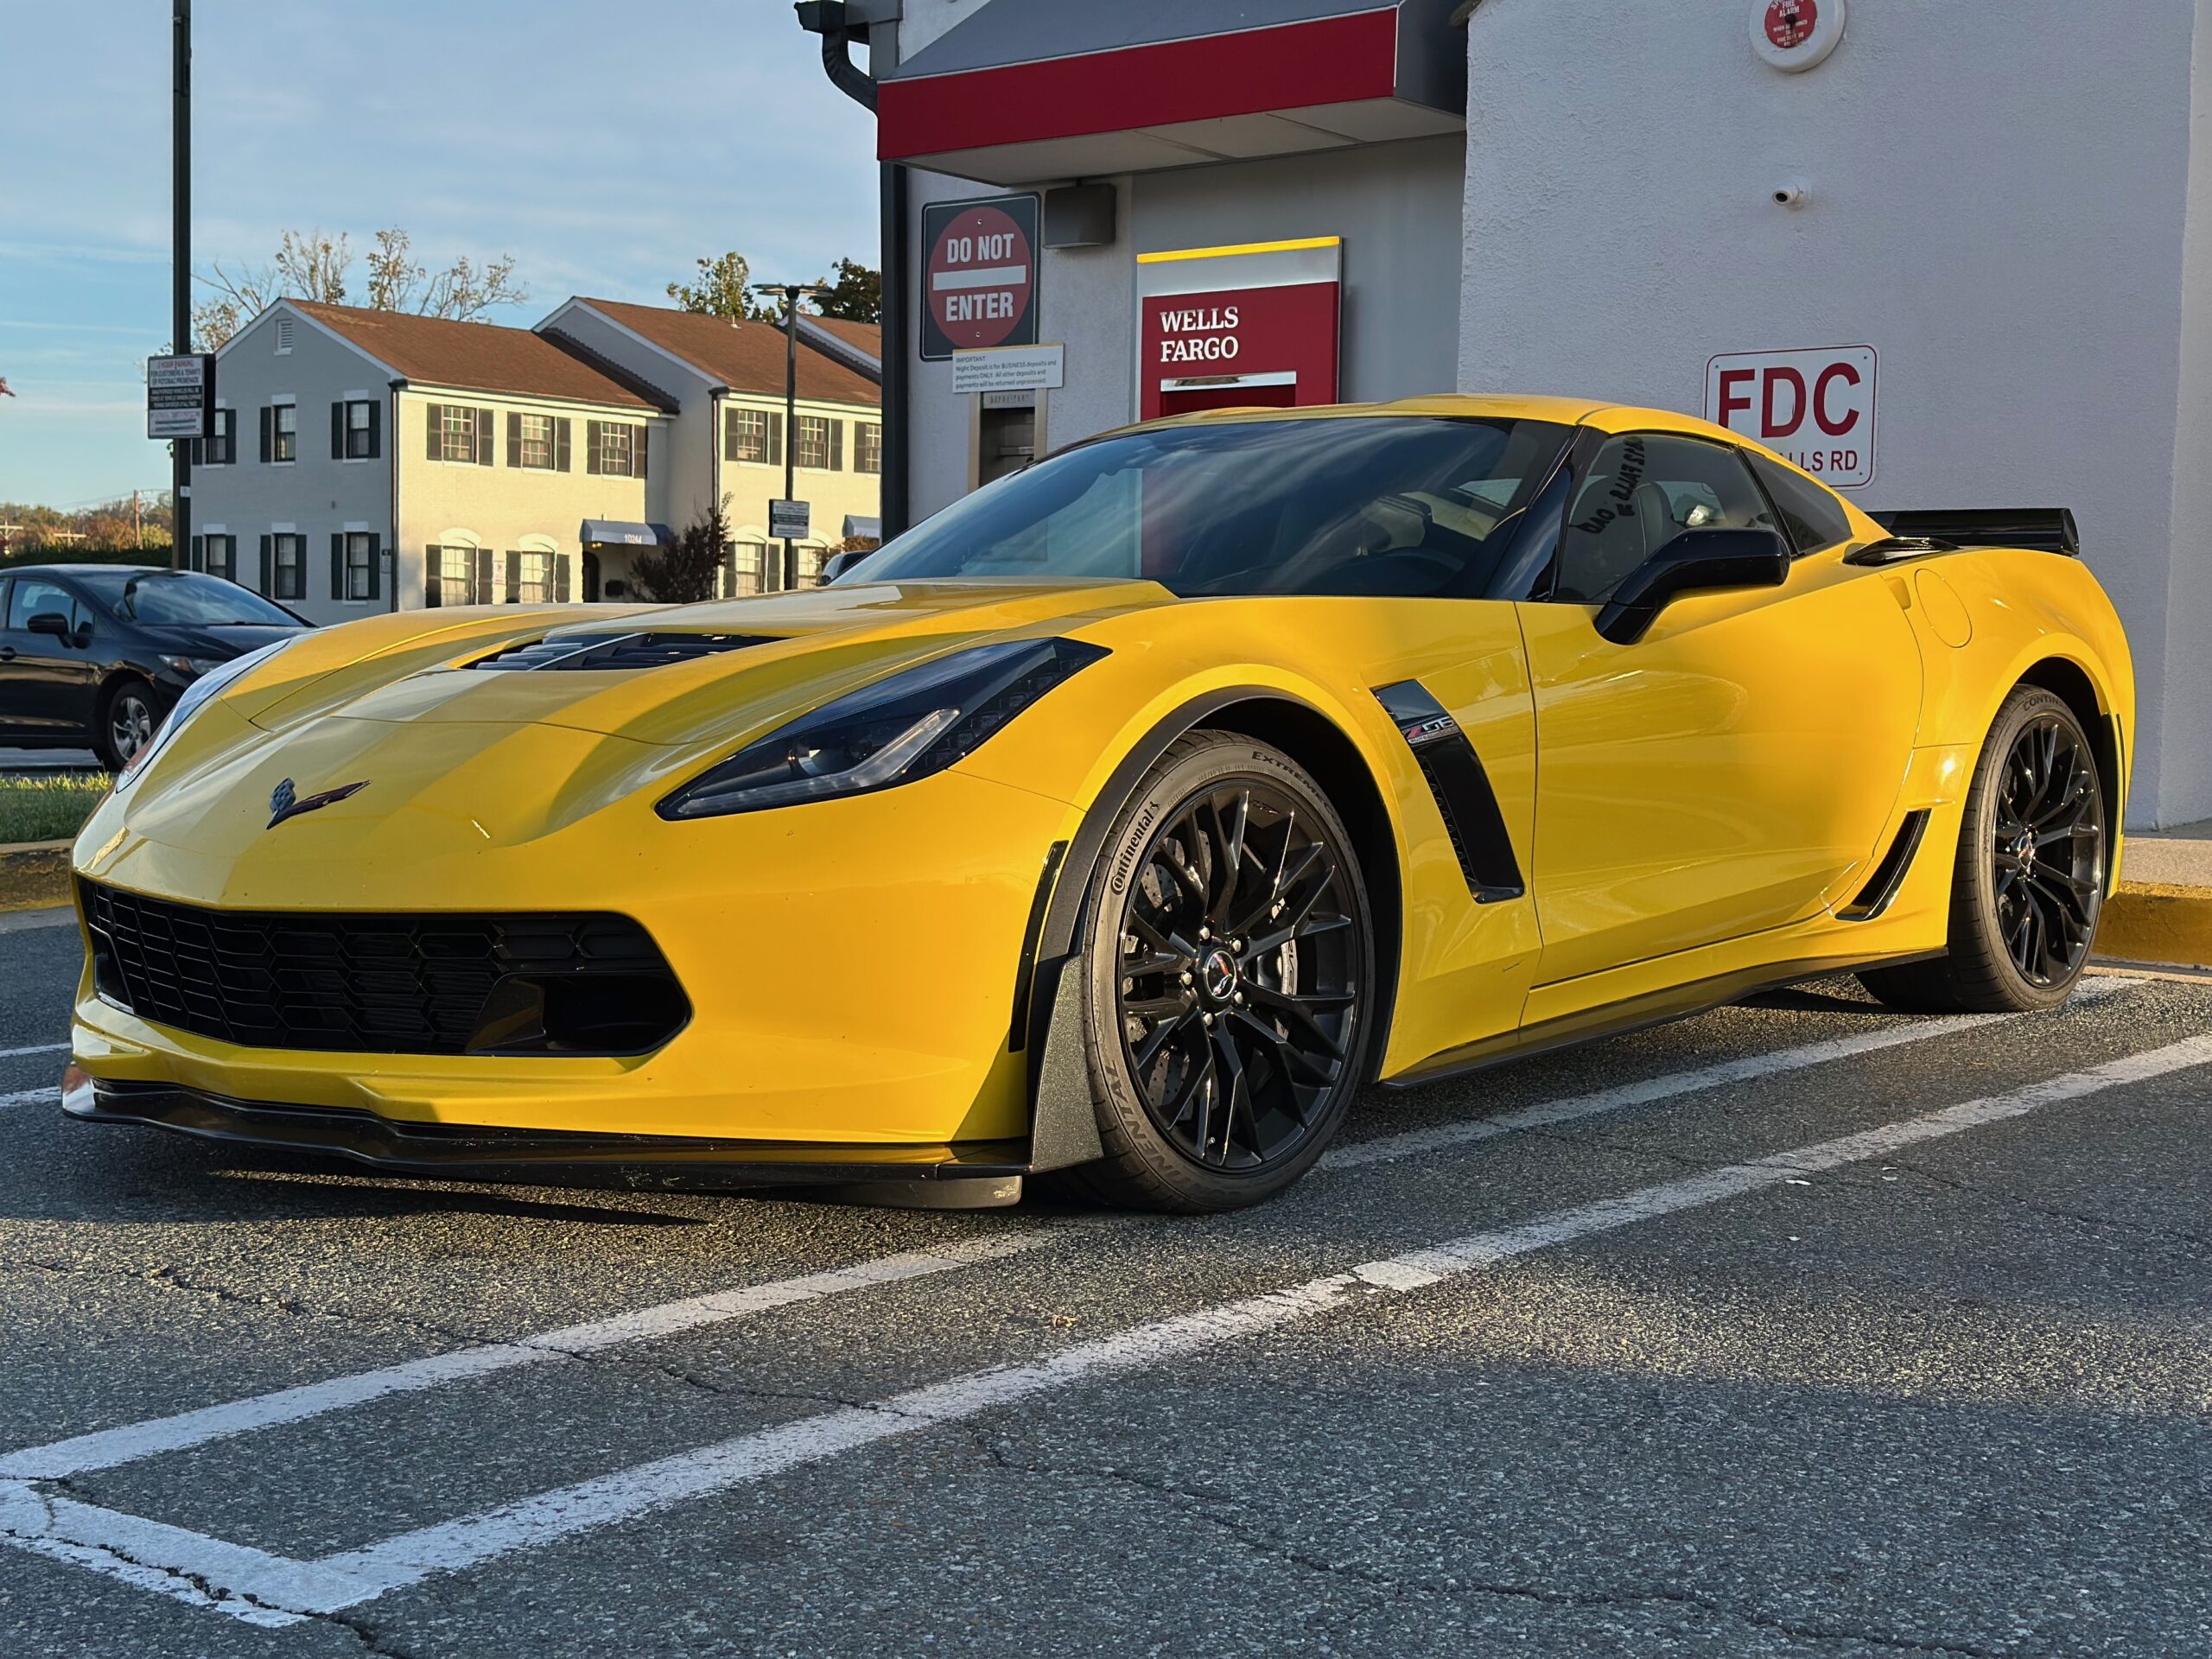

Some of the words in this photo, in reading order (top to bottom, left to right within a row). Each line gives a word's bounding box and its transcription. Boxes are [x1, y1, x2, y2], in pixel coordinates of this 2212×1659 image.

[1779, 6, 1800, 18] ALARM
[947, 238, 972, 264] DO
[977, 233, 1014, 262] NOT
[945, 291, 1014, 322] ENTER
[1160, 306, 1239, 333] WELLS
[1160, 335, 1239, 363] FARGO
[1718, 362, 1861, 438] FDC
[1830, 450, 1858, 471] RD
[1402, 716, 1454, 740] Z06
[1110, 809, 1154, 896] Continental
